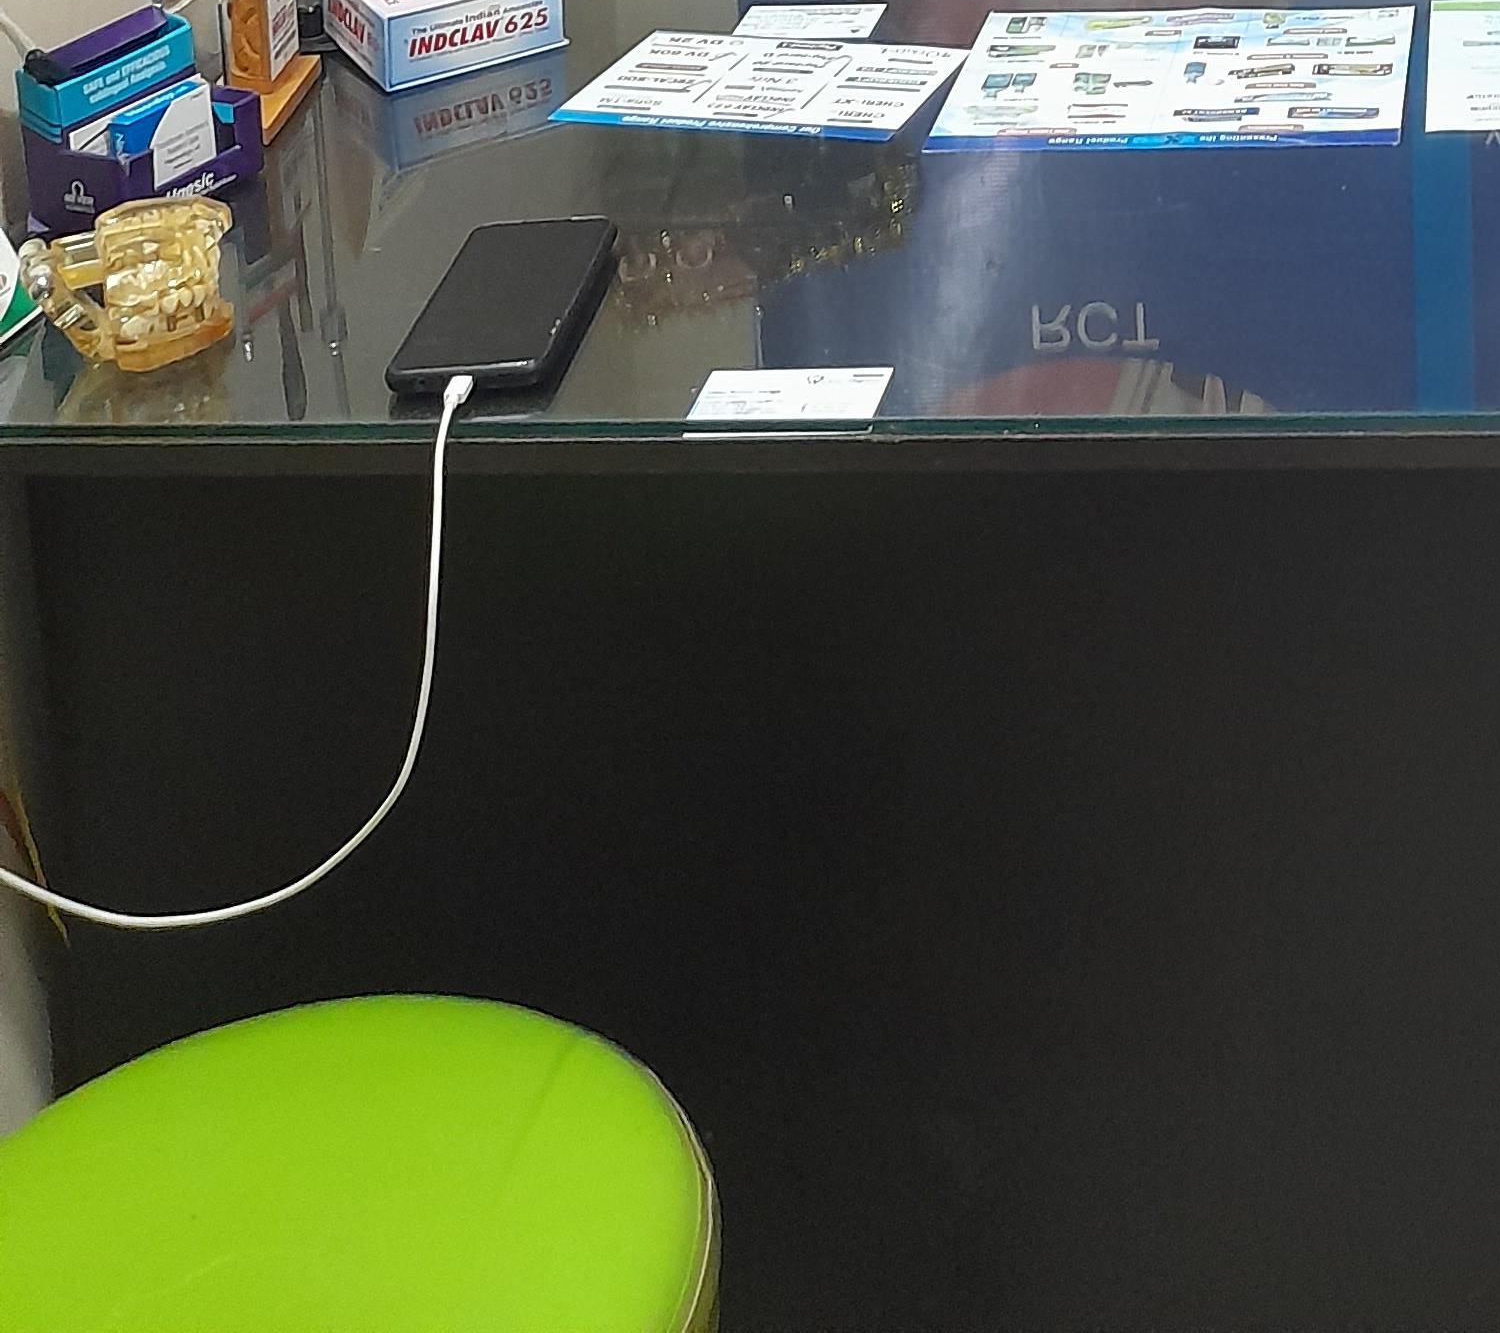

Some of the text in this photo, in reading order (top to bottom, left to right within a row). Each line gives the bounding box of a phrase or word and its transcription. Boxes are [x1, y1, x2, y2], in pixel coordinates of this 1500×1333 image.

[408, 7, 549, 58] INDCLAV 625
[464, 7, 501, 25] Indian
